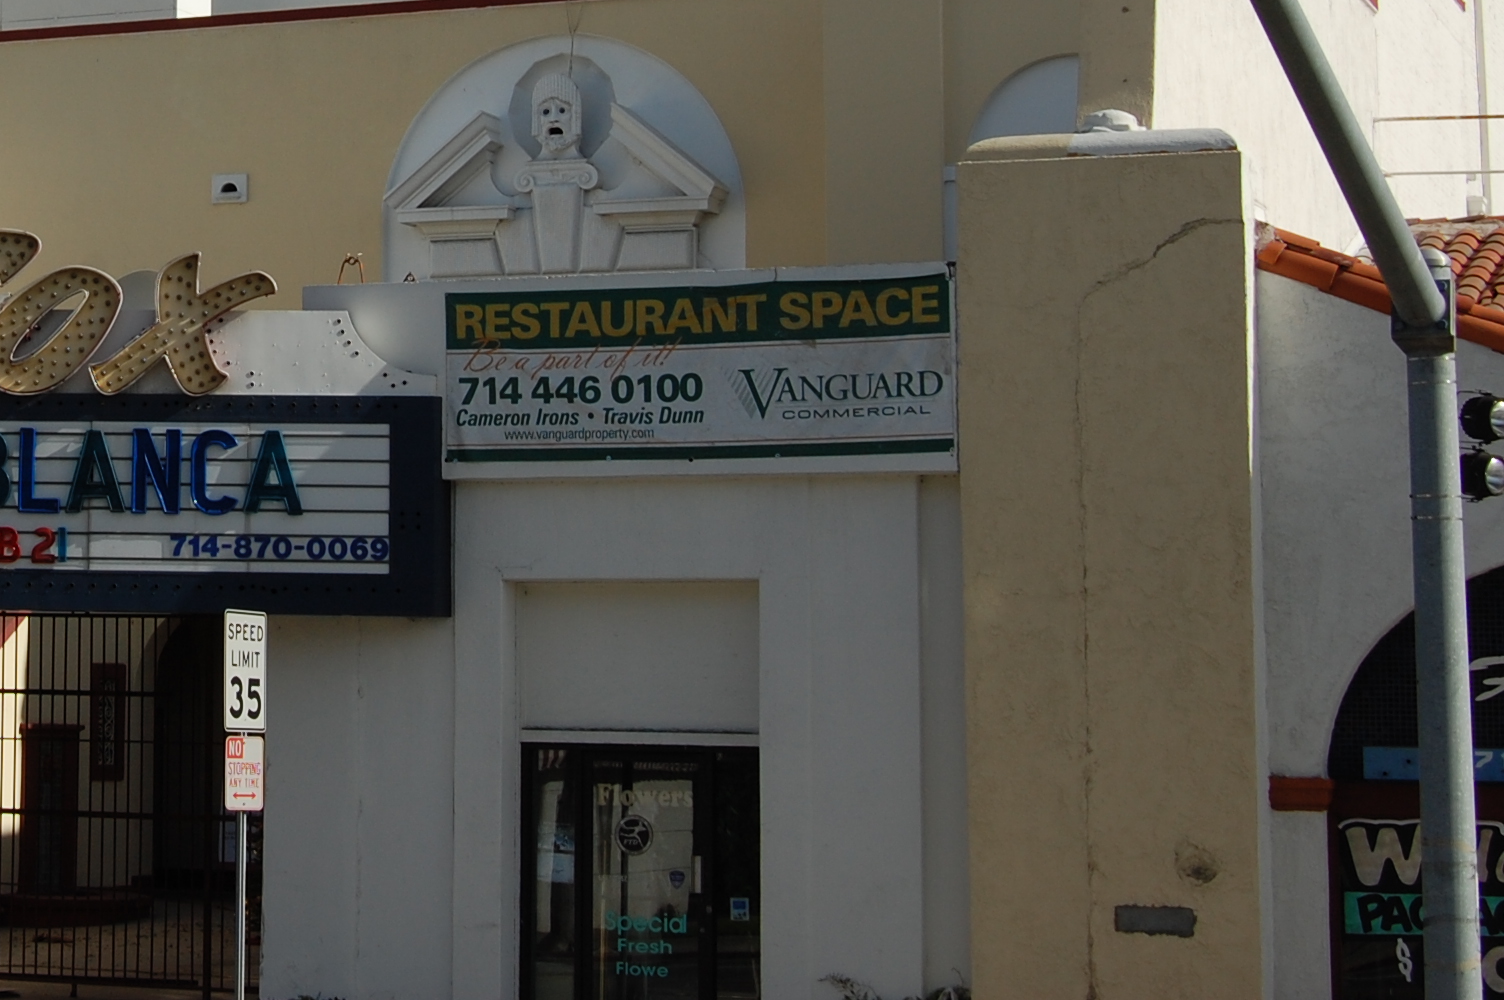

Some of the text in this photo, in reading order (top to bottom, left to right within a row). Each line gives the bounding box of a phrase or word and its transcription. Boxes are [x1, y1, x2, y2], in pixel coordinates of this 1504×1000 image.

[454, 285, 940, 340] RESTAURANT SPACE
[458, 372, 703, 405] 714 446 0100
[738, 367, 943, 420] VANGUARD
[456, 406, 704, 427] Cameron Irons Travis Dunn
[782, 405, 931, 420] COMMERCIAL
[504, 428, 654, 442] www.vanguardproperty.com
[31, 525, 68, 565] 21
[169, 533, 389, 561] 714-870-0069
[228, 623, 264, 642] SPEED
[231, 649, 260, 668] LIMIT
[229, 676, 262, 719] 35
[228, 740, 242, 757] NO
[228, 762, 261, 776] STOPPING
[229, 778, 259, 788] ANY TIME
[596, 783, 693, 807] Flowers
[605, 911, 688, 935] Special
[617, 938, 673, 954] Fresh
[616, 961, 669, 978] Flowe
